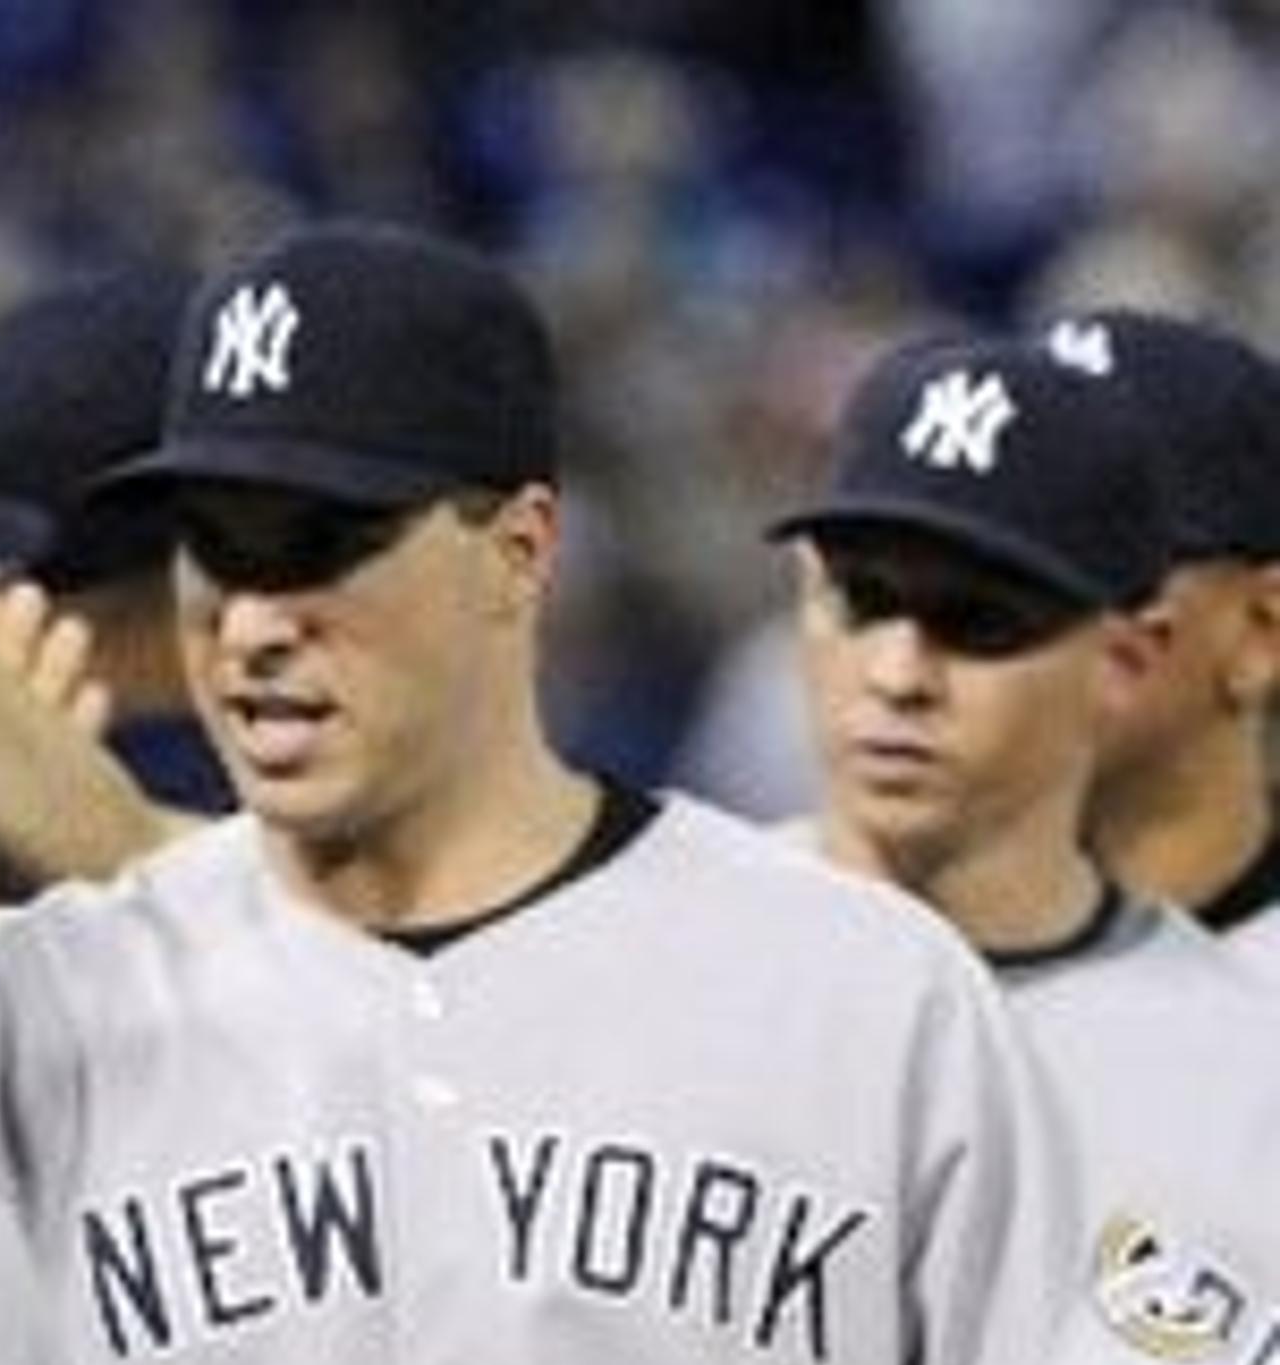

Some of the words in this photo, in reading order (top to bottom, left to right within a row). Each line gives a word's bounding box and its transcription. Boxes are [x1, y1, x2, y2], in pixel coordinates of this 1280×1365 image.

[203, 281, 301, 398] NY
[900, 368, 1019, 475] NY
[80, 1142, 385, 1358] NEW
[488, 1135, 868, 1363] YORK
